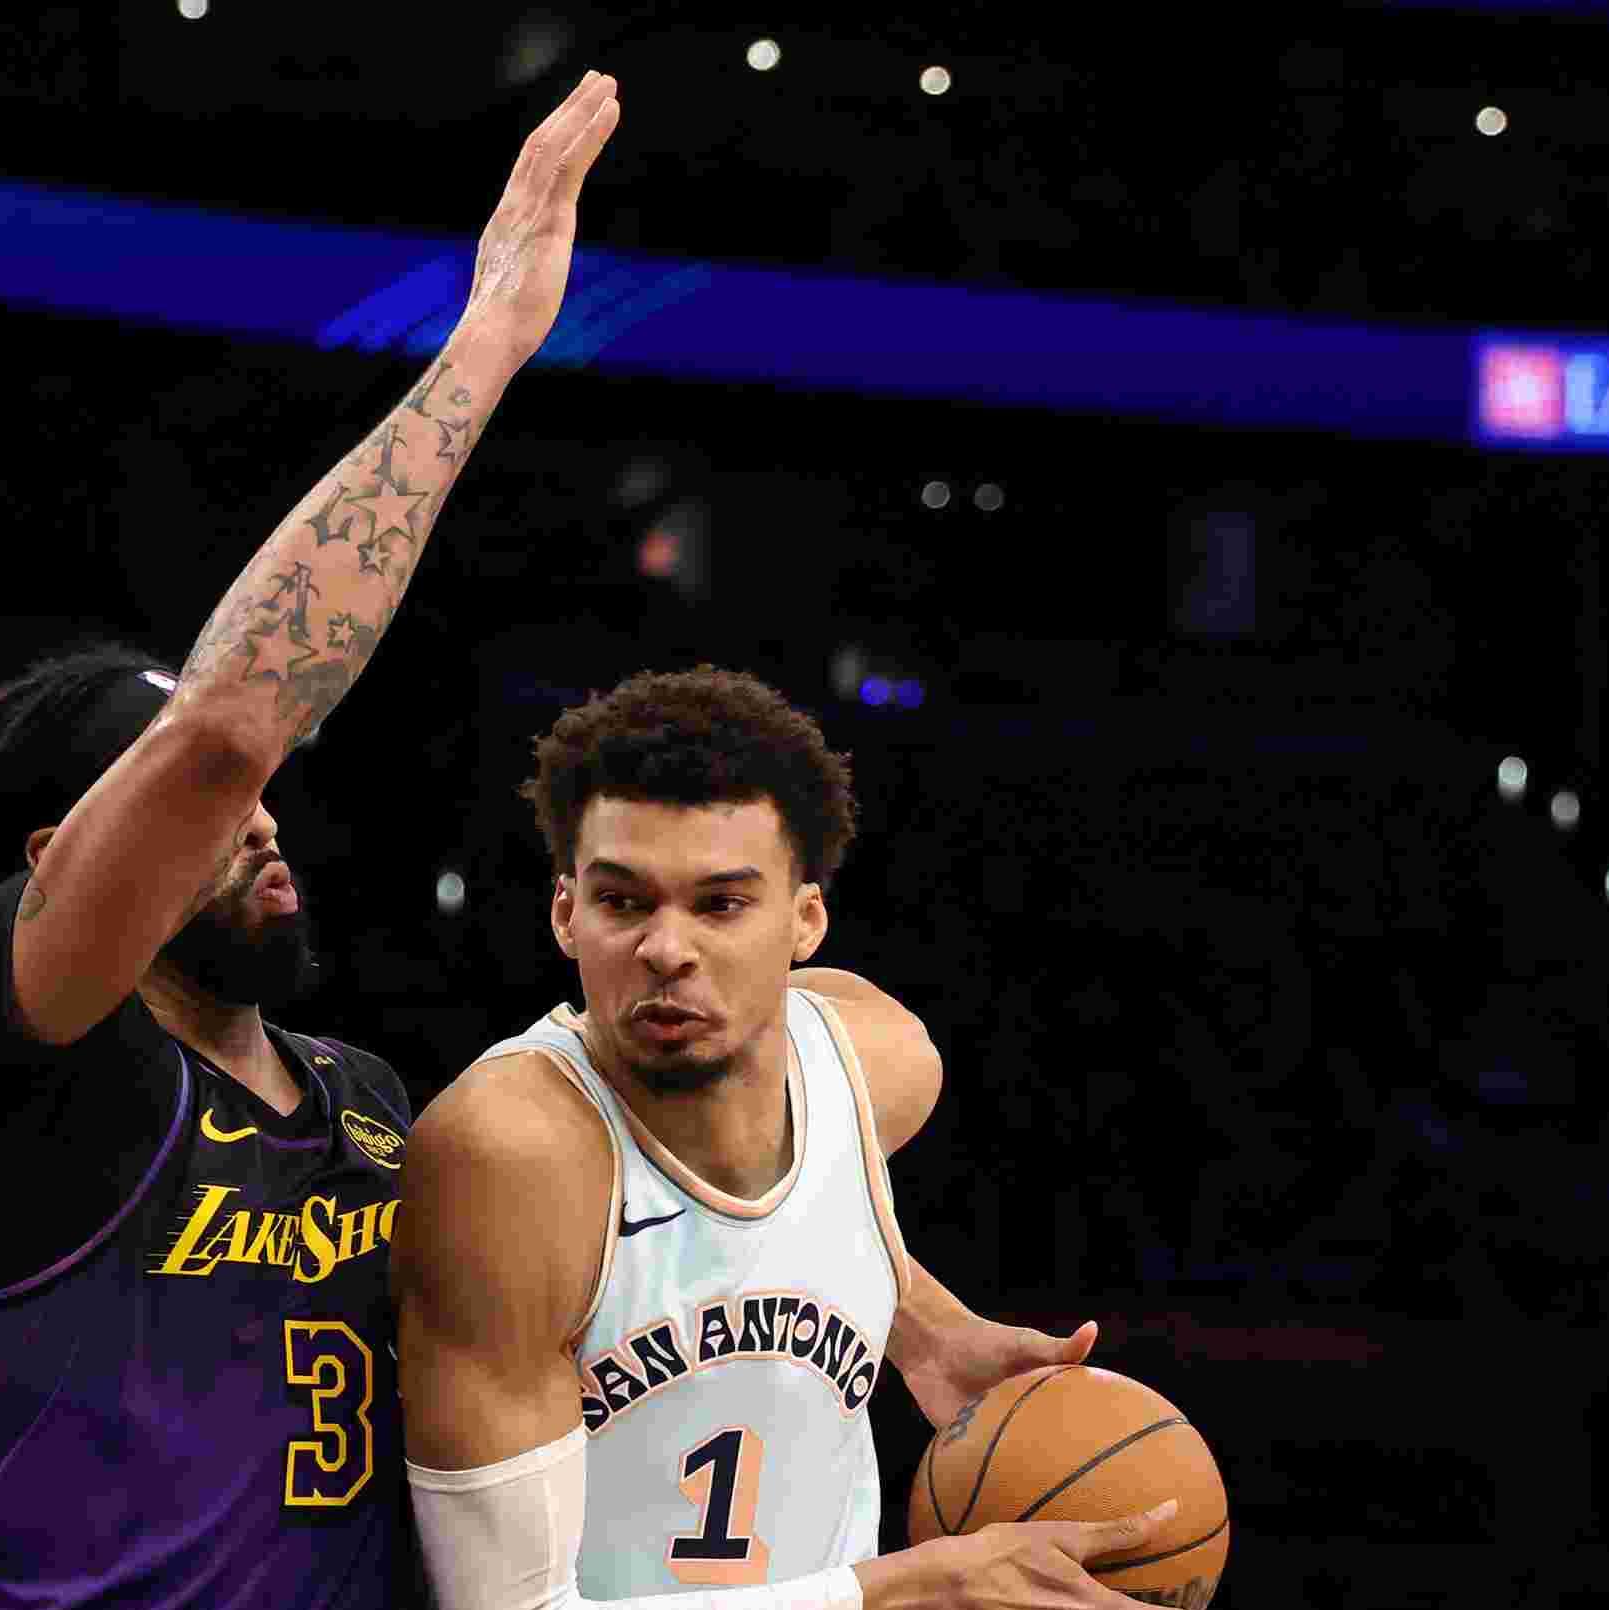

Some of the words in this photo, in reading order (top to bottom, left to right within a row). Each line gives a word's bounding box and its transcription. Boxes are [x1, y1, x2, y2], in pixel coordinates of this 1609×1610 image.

[284, 1319, 374, 1506] 3
[697, 1297, 876, 1411] ANTONIO
[667, 1426, 764, 1577] 1
